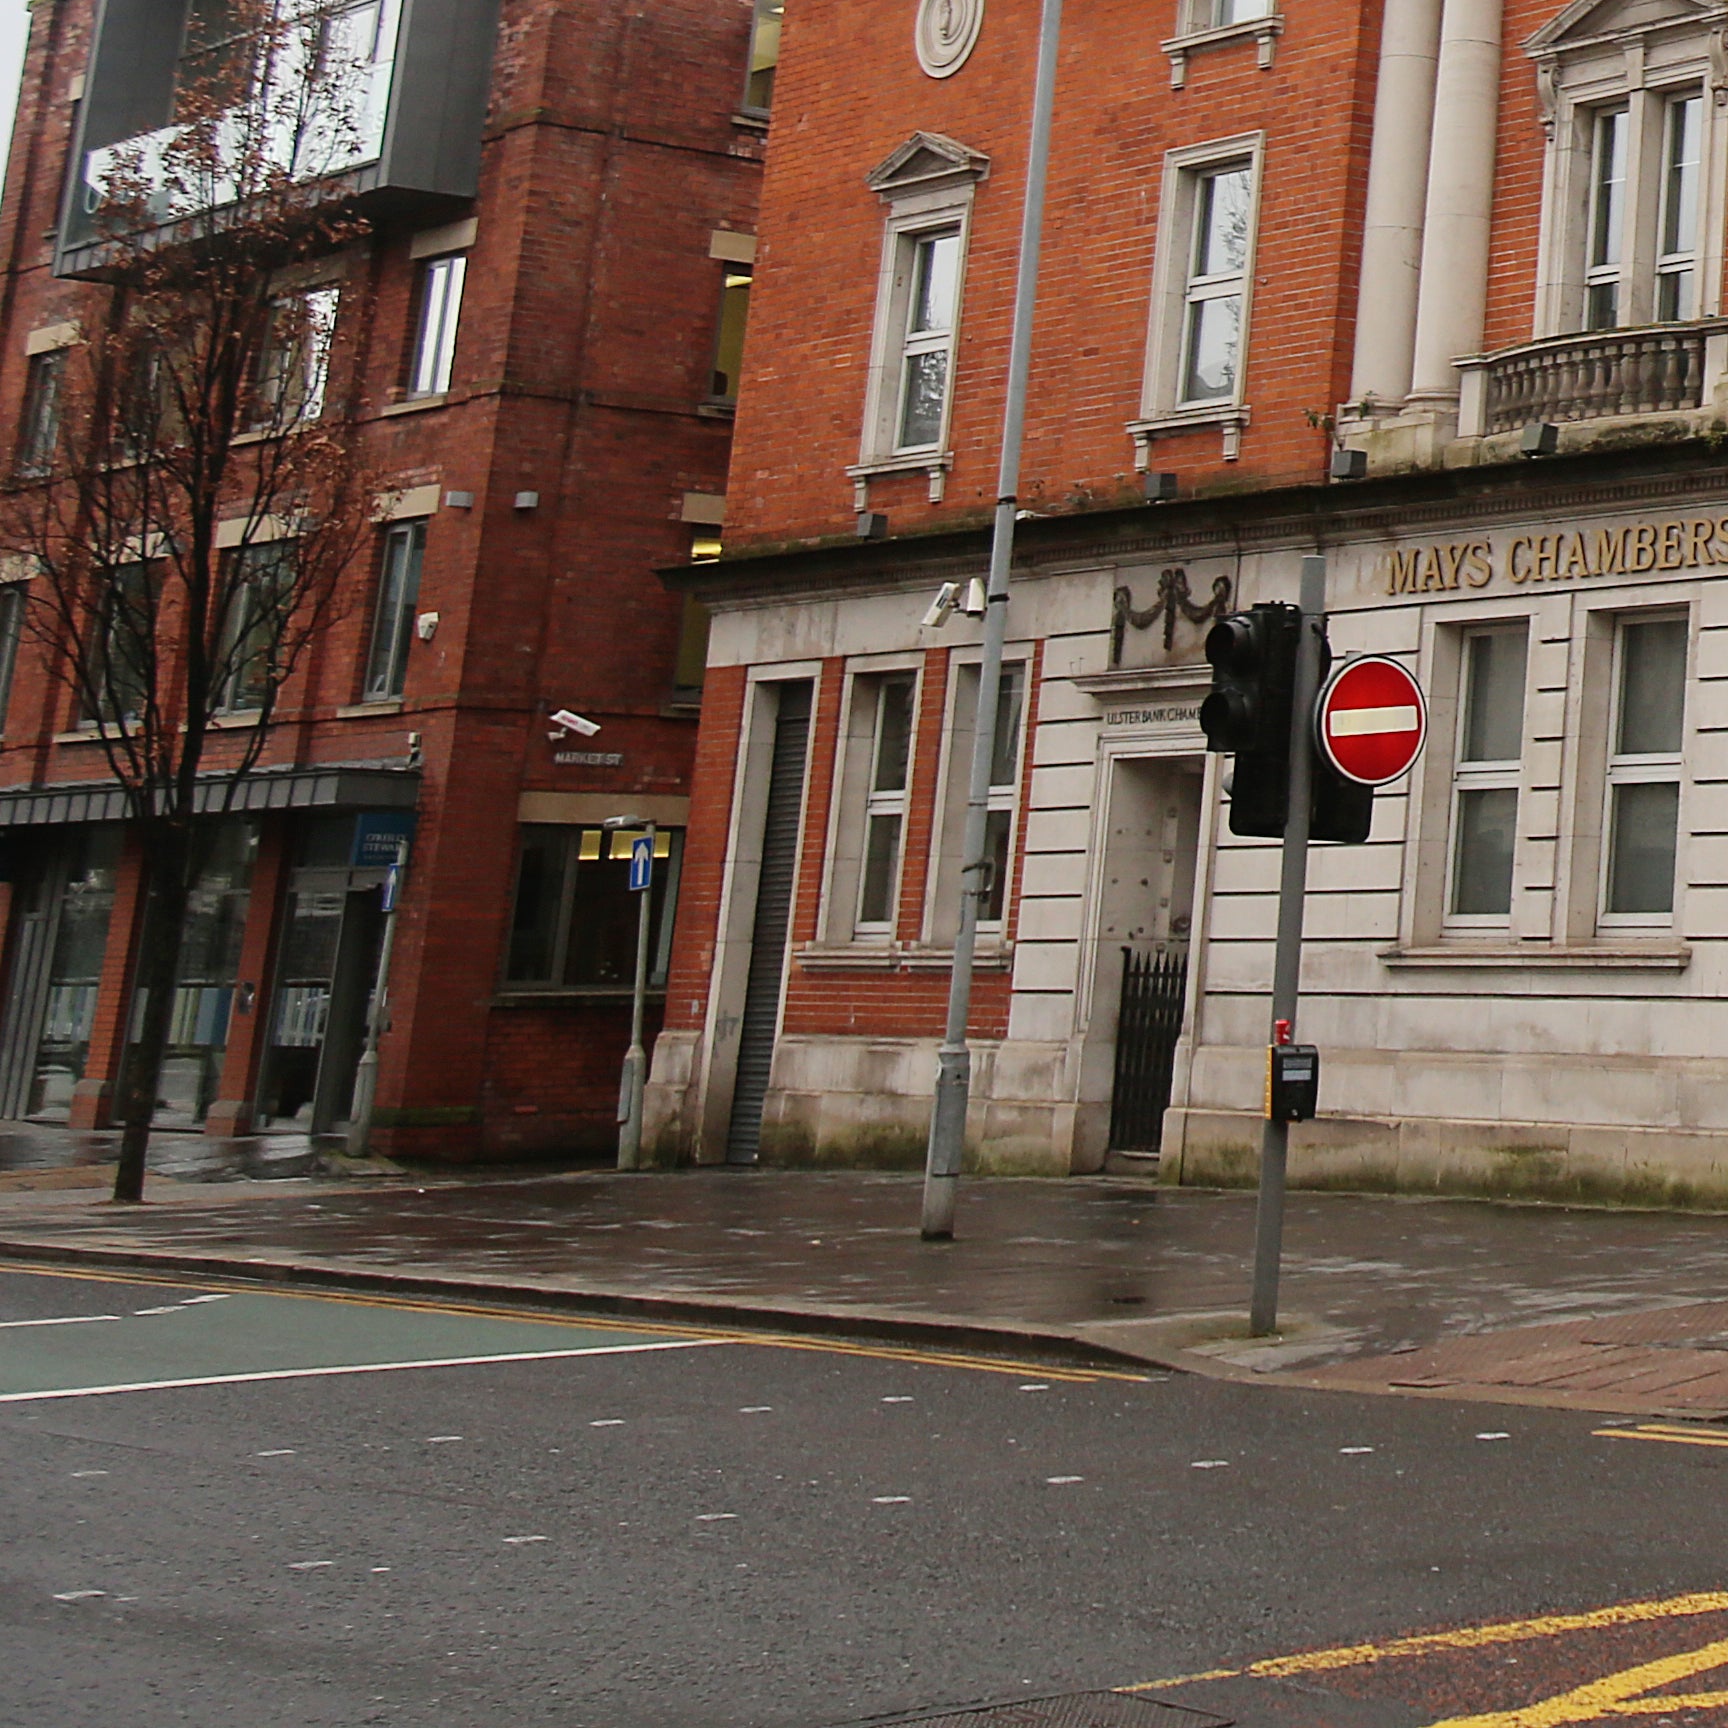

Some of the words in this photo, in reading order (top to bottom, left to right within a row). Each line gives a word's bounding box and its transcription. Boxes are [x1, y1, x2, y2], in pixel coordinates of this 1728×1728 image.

[1385, 541, 1492, 595] MAYS
[1107, 712, 1142, 725] ULSTER
[1142, 709, 1167, 723] BANK
[555, 752, 601, 765] MARKET
